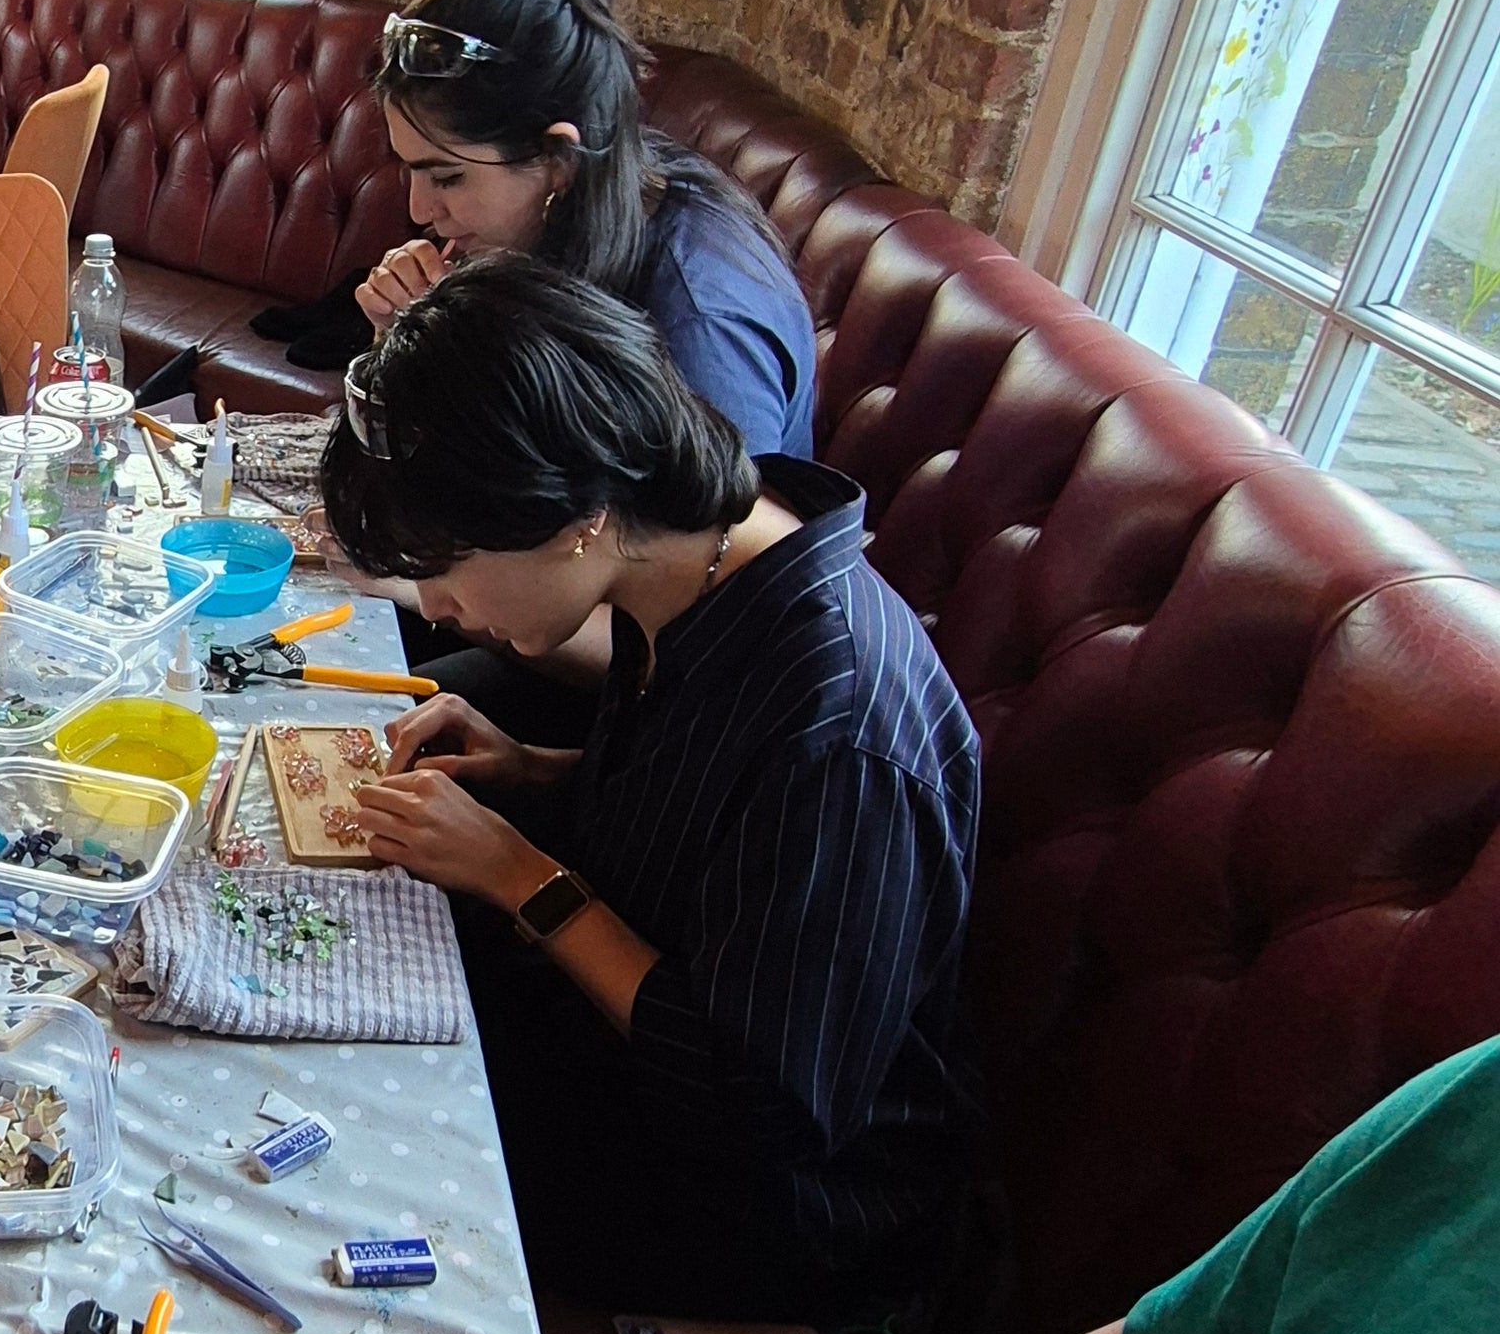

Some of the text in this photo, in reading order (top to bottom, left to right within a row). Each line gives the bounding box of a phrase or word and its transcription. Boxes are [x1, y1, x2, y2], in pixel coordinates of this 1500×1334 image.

[286, 1124, 319, 1146] ERASER
[290, 1130, 325, 1153] PLASTIC
[351, 1244, 394, 1253] PLASTIC
[353, 1249, 398, 1259] ERASER
